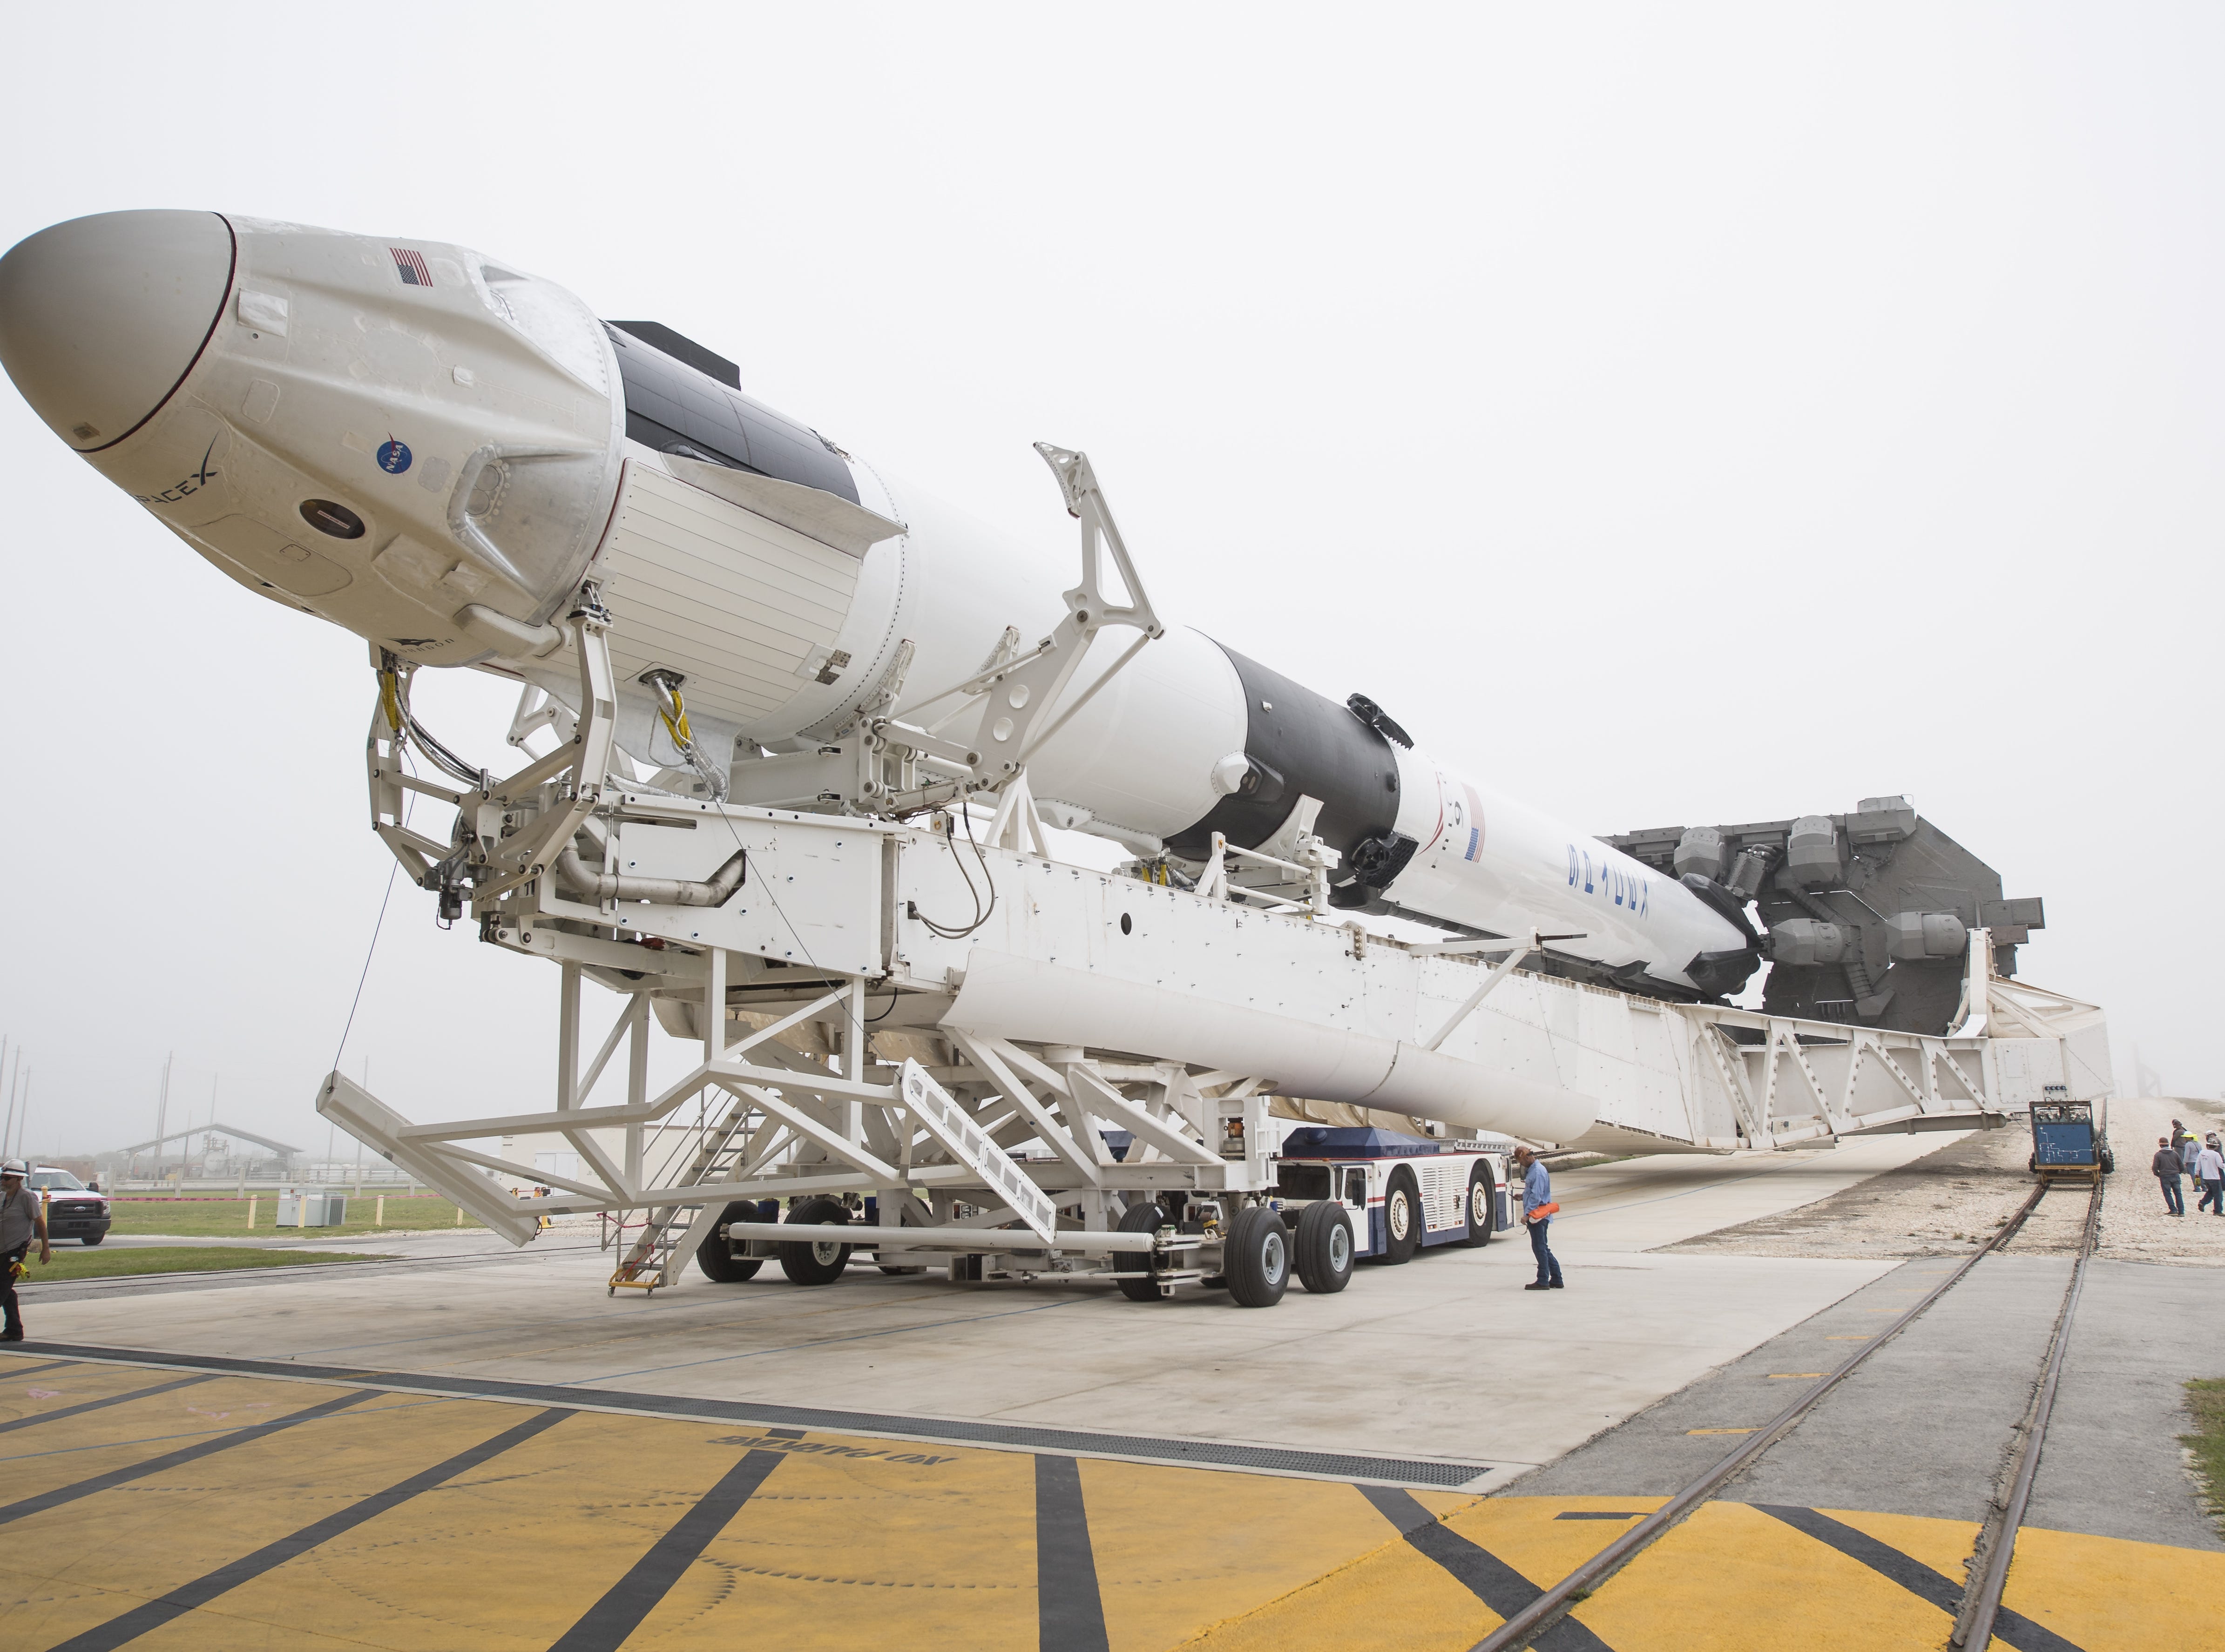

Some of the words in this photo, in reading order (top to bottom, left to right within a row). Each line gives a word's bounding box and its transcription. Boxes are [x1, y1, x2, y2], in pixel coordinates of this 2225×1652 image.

[132, 427, 220, 503] PACEX
[386, 445, 403, 471] NASA
[399, 638, 455, 653] DRAGON
[706, 1436, 892, 1458] PARKING
[884, 1454, 959, 1466] NO
